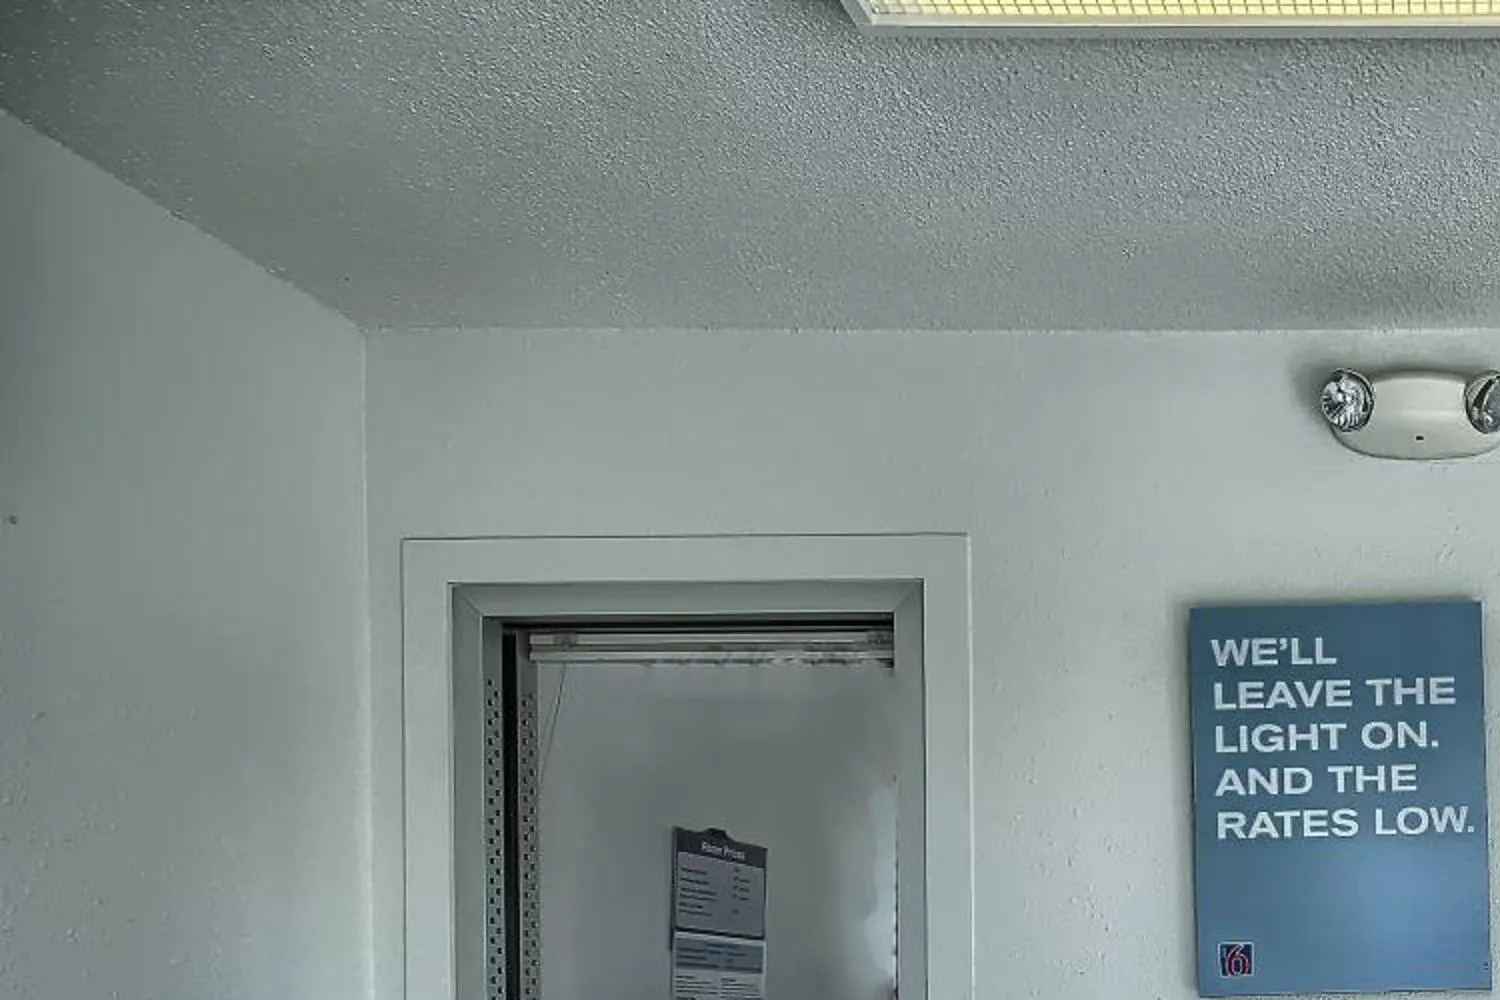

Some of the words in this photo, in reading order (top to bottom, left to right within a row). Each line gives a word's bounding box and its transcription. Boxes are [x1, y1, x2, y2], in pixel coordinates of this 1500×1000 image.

[1211, 637, 1337, 667] WE'LL
[1213, 679, 1353, 711] LEAVE
[1366, 676, 1457, 706] THE
[1215, 723, 1347, 753] LIGHT
[1361, 720, 1439, 750] ON.
[1215, 767, 1313, 797] AND
[1328, 764, 1418, 793] THE
[1217, 808, 1359, 839] RATES
[1375, 805, 1475, 836] LOW.
